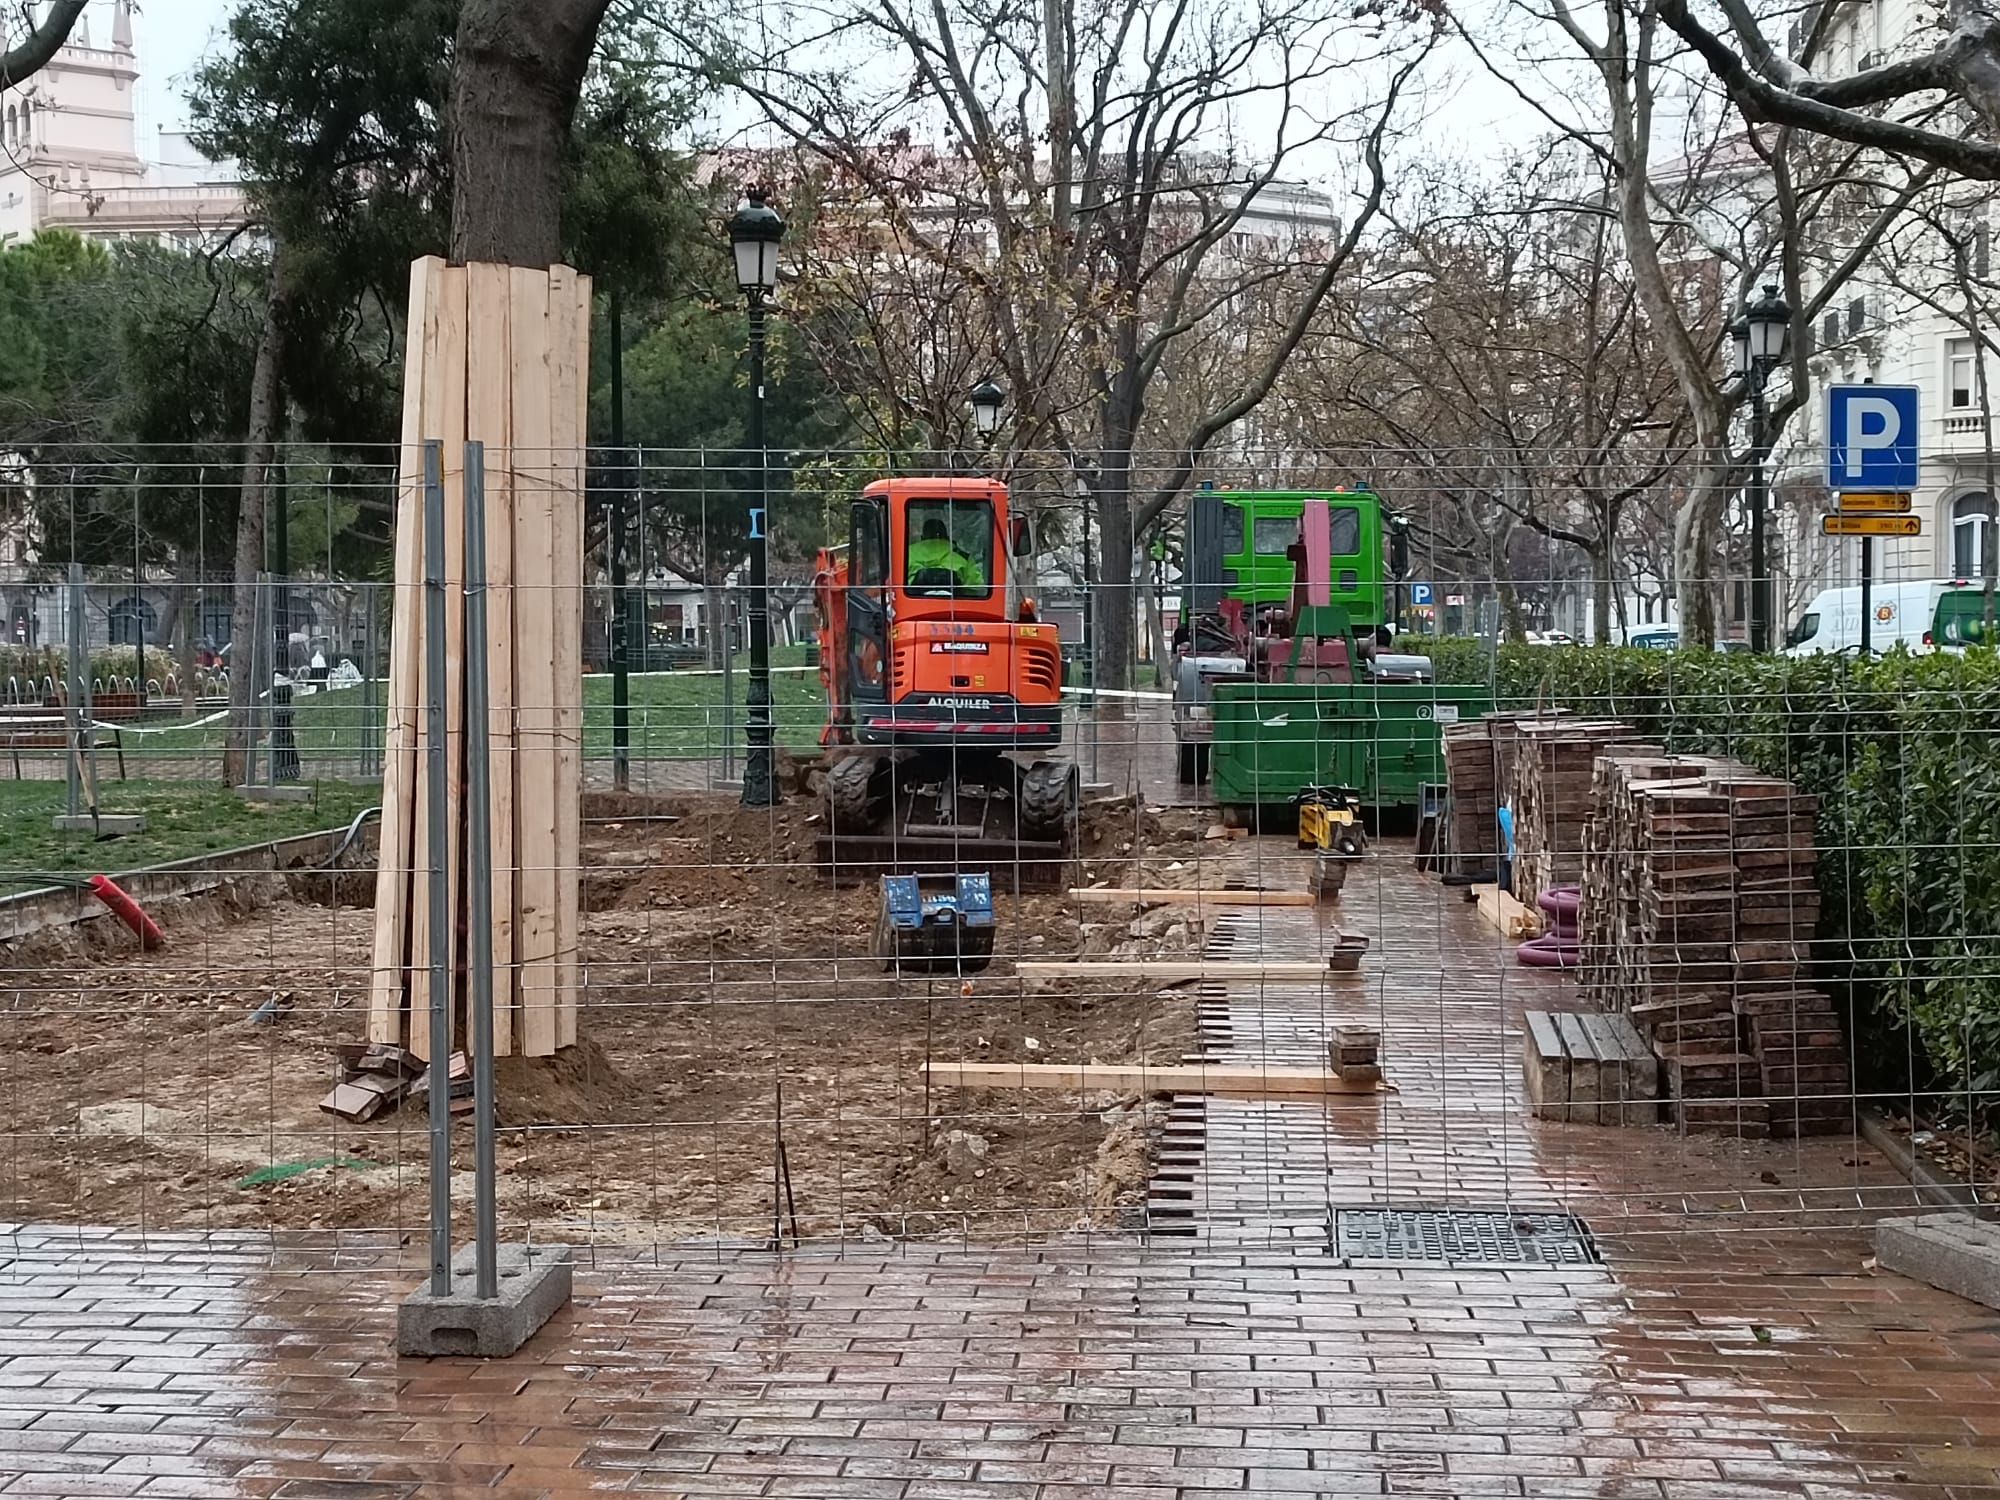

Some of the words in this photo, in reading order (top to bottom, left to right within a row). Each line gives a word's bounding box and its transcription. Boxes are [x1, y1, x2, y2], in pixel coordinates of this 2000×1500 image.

[1846, 397, 1901, 477] P
[1415, 585, 1430, 603] P
[928, 697, 990, 709] ALQUILER
[1421, 708, 1427, 718] 2
